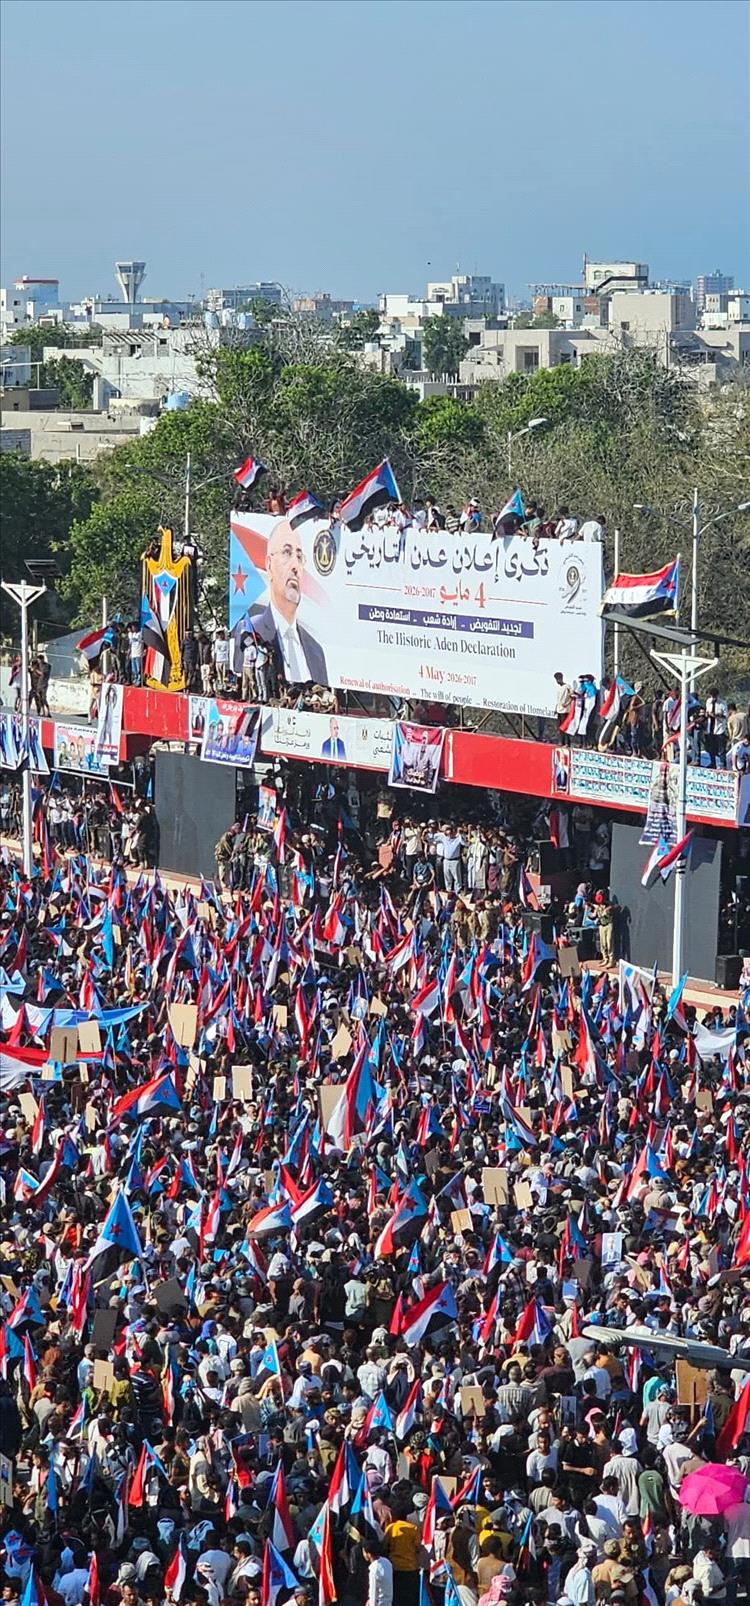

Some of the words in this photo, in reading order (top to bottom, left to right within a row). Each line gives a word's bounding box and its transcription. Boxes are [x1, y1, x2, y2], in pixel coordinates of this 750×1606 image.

[345, 535, 405, 575] التاريخي
[411, 545, 448, 570] عدن
[452, 544, 499, 583] إعلان
[505, 548, 549, 582] ذكرى
[404, 585, 436, 598] 2026-2017
[439, 579, 470, 605] مايو
[474, 582, 486, 608] 4
[369, 608, 385, 621] وطن
[422, 614, 441, 626] شعب
[469, 618, 500, 632] التفويض
[501, 622, 522, 635] تجديد
[377, 629, 394, 645] The
[396, 631, 431, 648] Historic
[433, 636, 458, 652] Aden
[460, 639, 515, 658] Declaration
[419, 664, 424, 678] 4
[425, 665, 445, 684] May
[420, 688, 432, 699] The
[433, 690, 445, 701] will
[445, 691, 452, 701] of
[452, 695, 473, 706] people
[482, 697, 519, 711] Restoration
[520, 703, 526, 713] of
